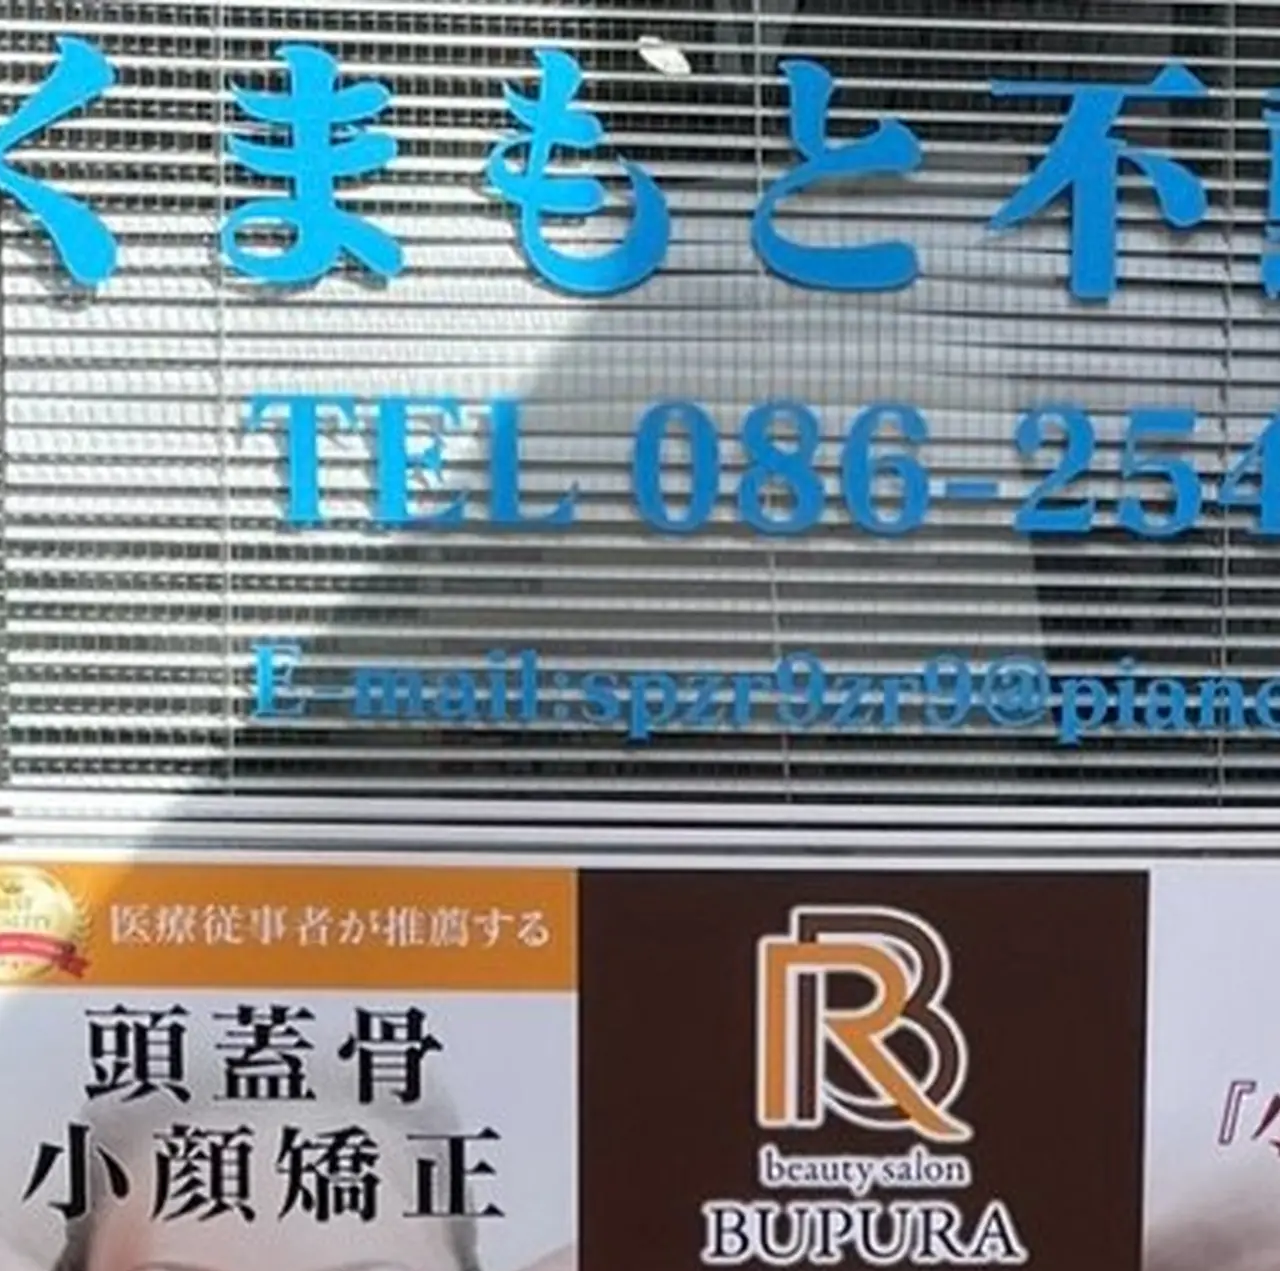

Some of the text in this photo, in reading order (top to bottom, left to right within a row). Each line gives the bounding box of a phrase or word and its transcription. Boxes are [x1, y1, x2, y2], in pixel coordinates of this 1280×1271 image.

[251, 394, 578, 531] TEL
[110, 904, 551, 948] 医療従事者が推薦する
[84, 1003, 444, 1106] 頭蓋骨
[23, 1121, 507, 1224] 小顔矯正
[761, 1146, 969, 1194] beauty salon
[704, 1203, 1024, 1262] BUPURA
